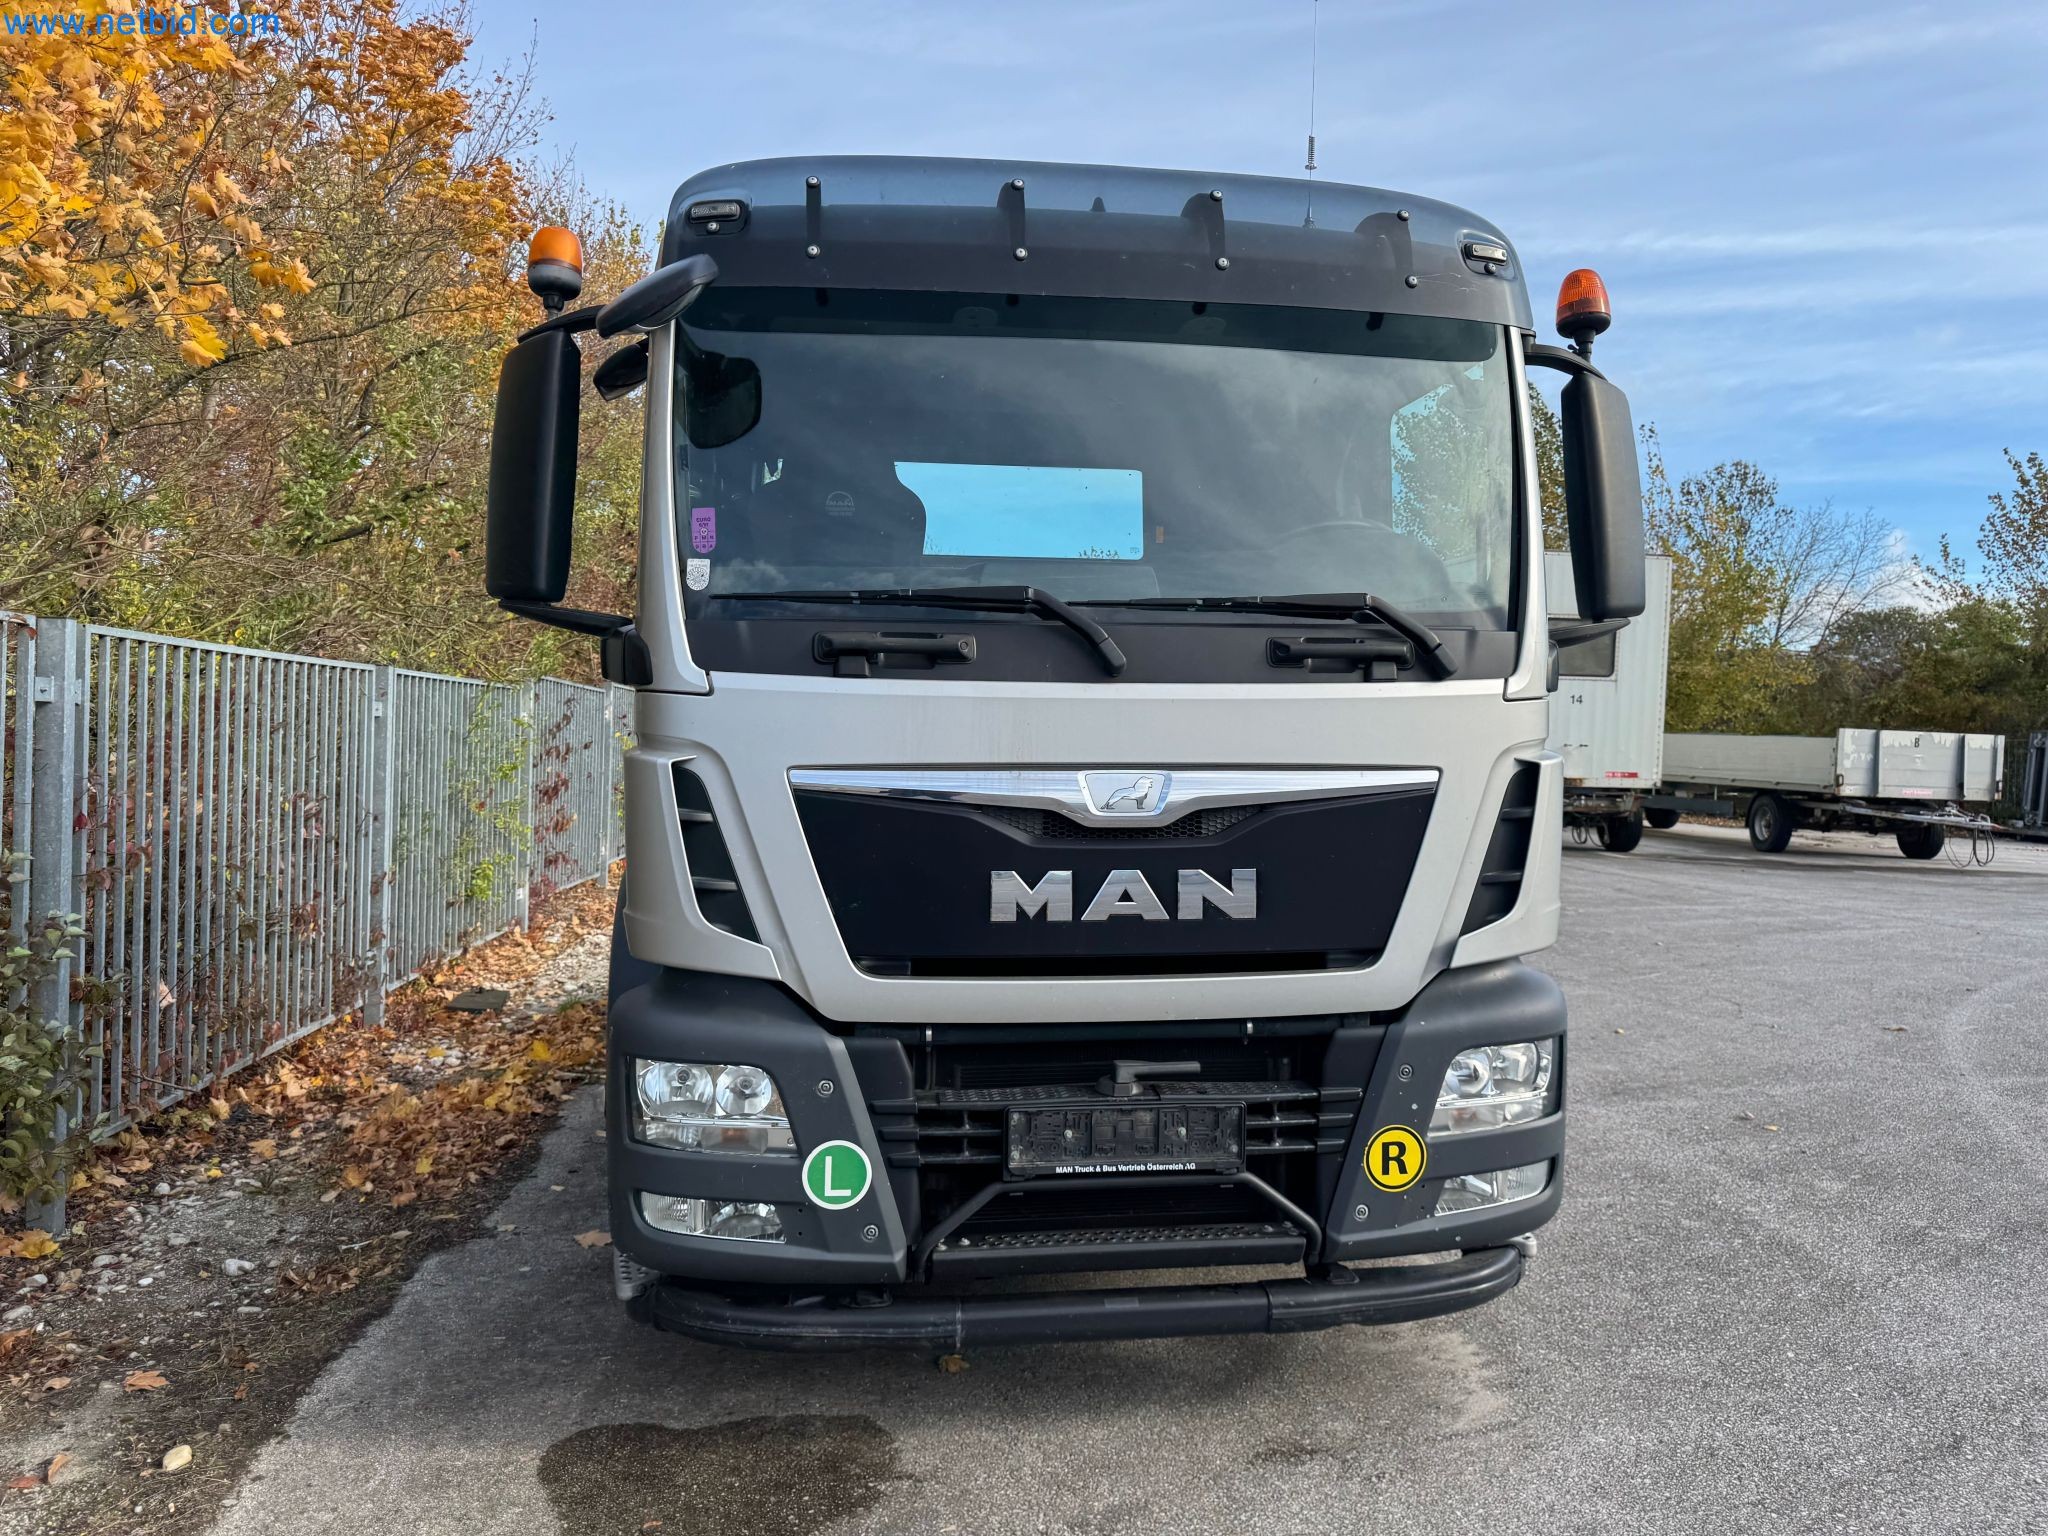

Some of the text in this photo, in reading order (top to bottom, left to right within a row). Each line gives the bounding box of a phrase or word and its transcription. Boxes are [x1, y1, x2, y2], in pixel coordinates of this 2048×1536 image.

[1570, 694, 1583, 704] 14
[990, 868, 1257, 922] MAN
[824, 1155, 852, 1197] L
[1055, 1162, 1196, 1174] MAN Truck & Bus Vertrieb Österreich AG
[1381, 1141, 1408, 1176] R
